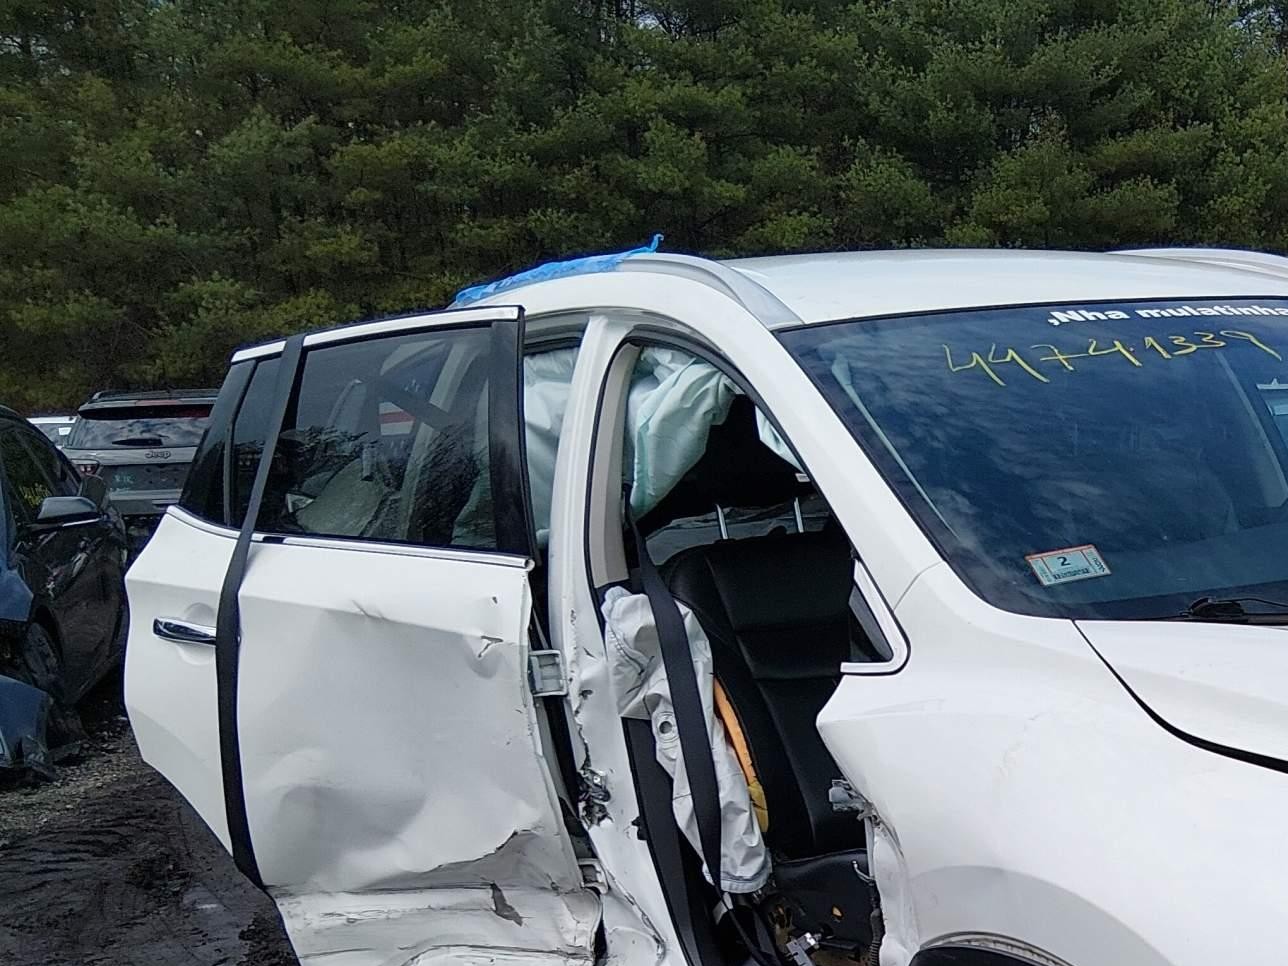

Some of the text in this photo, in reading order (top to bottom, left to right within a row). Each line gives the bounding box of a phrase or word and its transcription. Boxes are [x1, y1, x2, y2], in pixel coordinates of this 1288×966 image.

[942, 330, 1283, 387] 44741339
[145, 450, 172, 459] Jeep
[1056, 556, 1071, 567] 2
